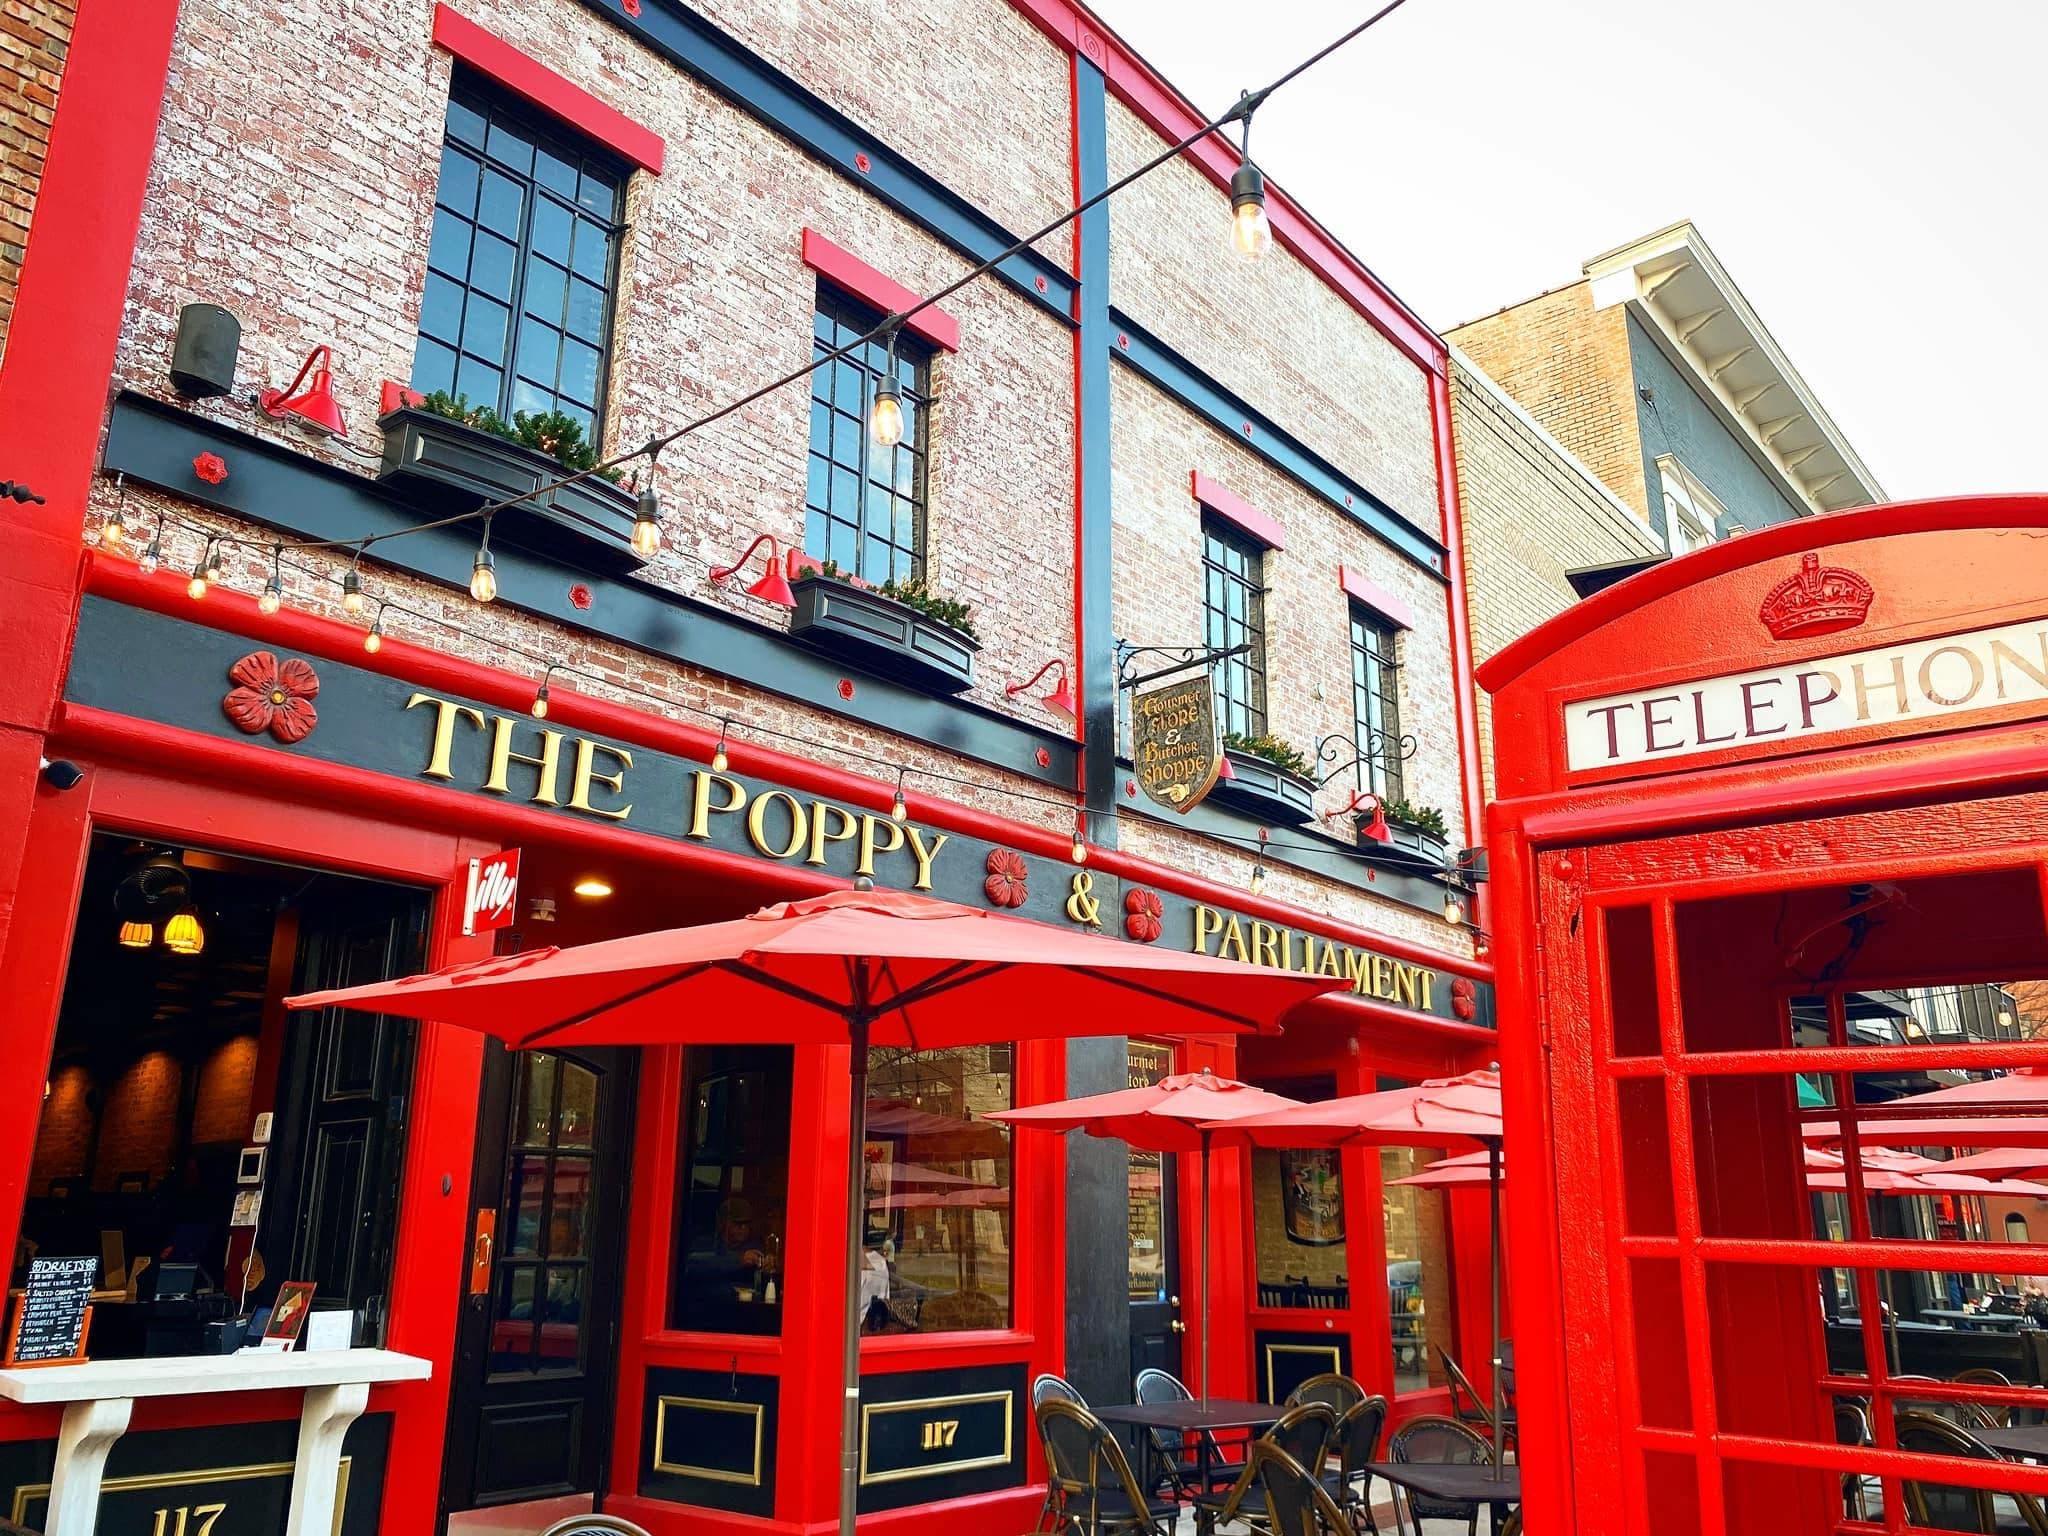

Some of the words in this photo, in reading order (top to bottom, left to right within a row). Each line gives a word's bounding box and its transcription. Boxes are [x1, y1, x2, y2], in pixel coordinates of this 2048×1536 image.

[1143, 691, 1201, 716] Gourmet
[1165, 729, 1181, 745] &
[1144, 740, 1199, 763] Butcher
[406, 692, 634, 820] THE
[687, 769, 950, 891] POPPY
[1066, 872, 1102, 926] &
[1193, 904, 1437, 1010] PARLIAMENT
[474, 861, 516, 920] illy
[42, 1260, 84, 1271] DRAFTS
[922, 1420, 959, 1450] 117
[153, 1503, 227, 1536] 117
